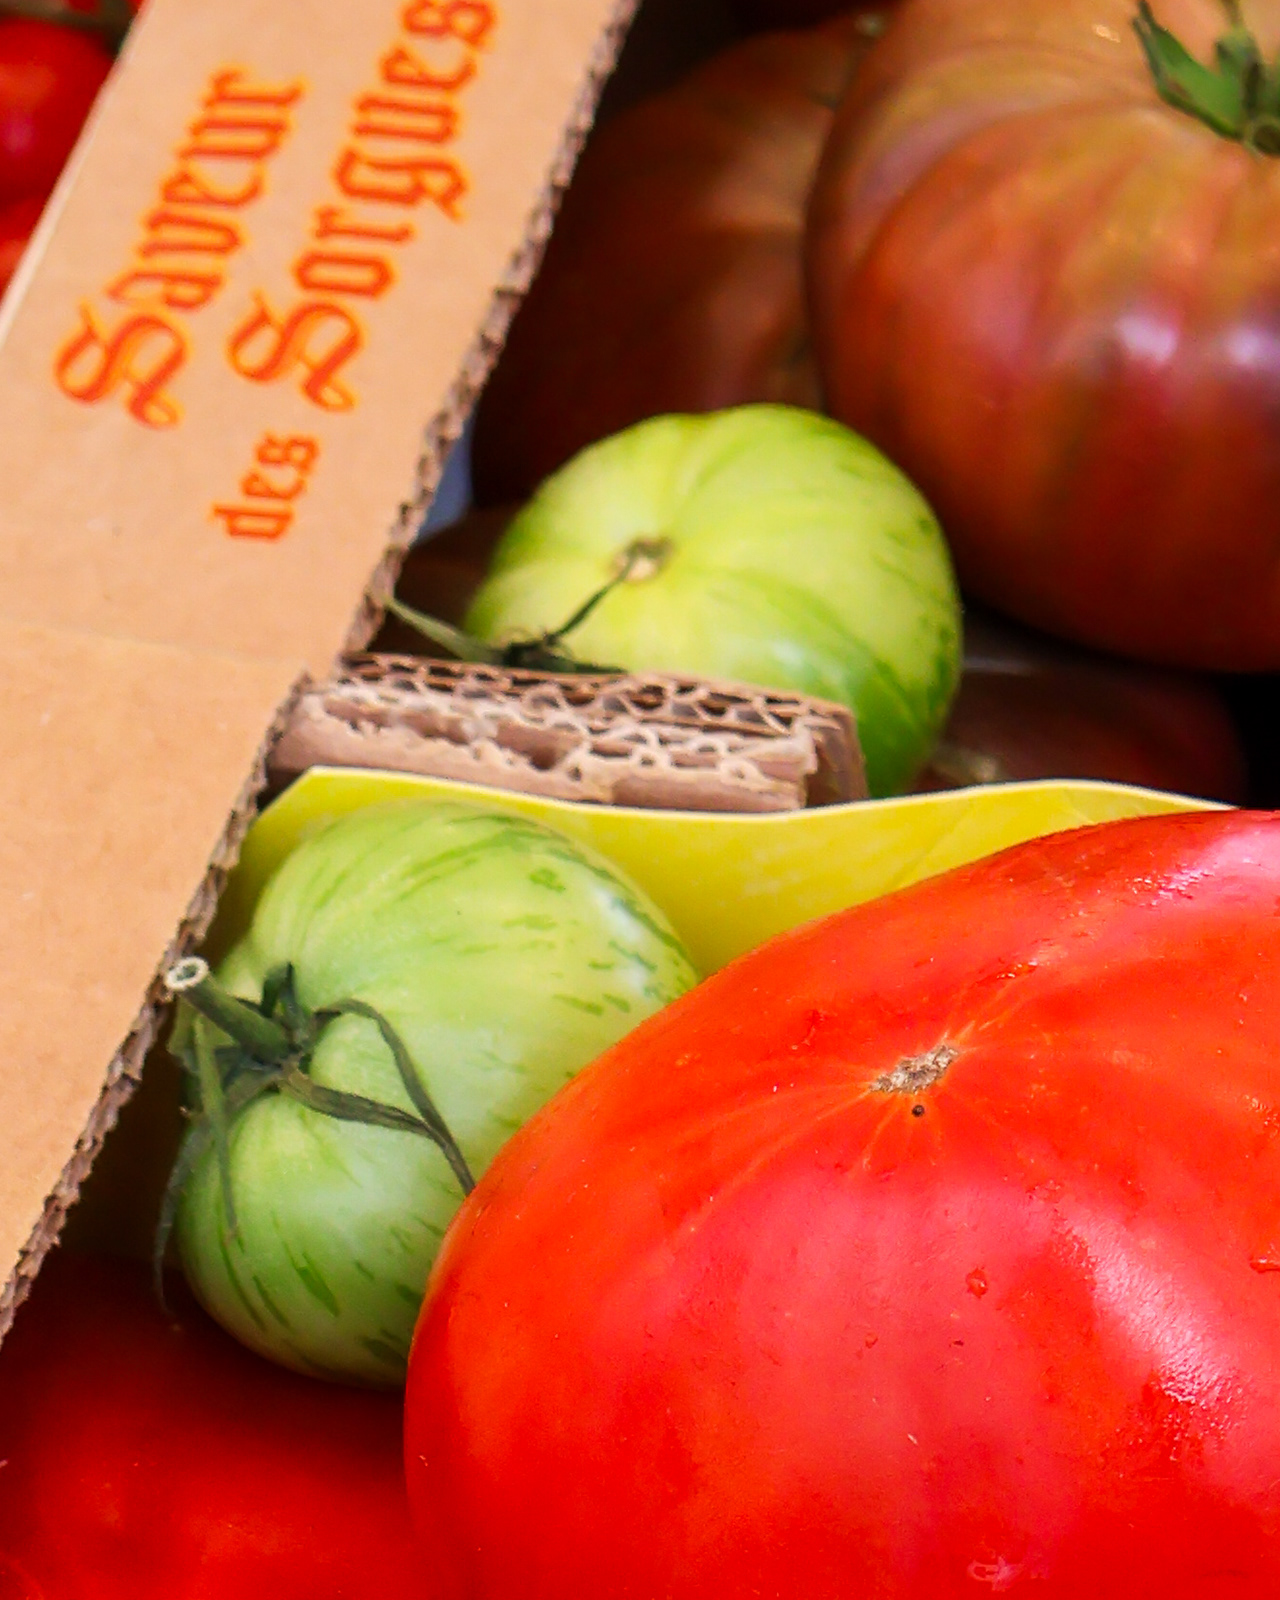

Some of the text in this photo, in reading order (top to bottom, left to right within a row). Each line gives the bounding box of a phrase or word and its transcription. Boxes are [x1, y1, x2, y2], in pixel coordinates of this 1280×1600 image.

[52, 64, 310, 430] Saveur
[209, 0, 498, 543] des Sorgues
